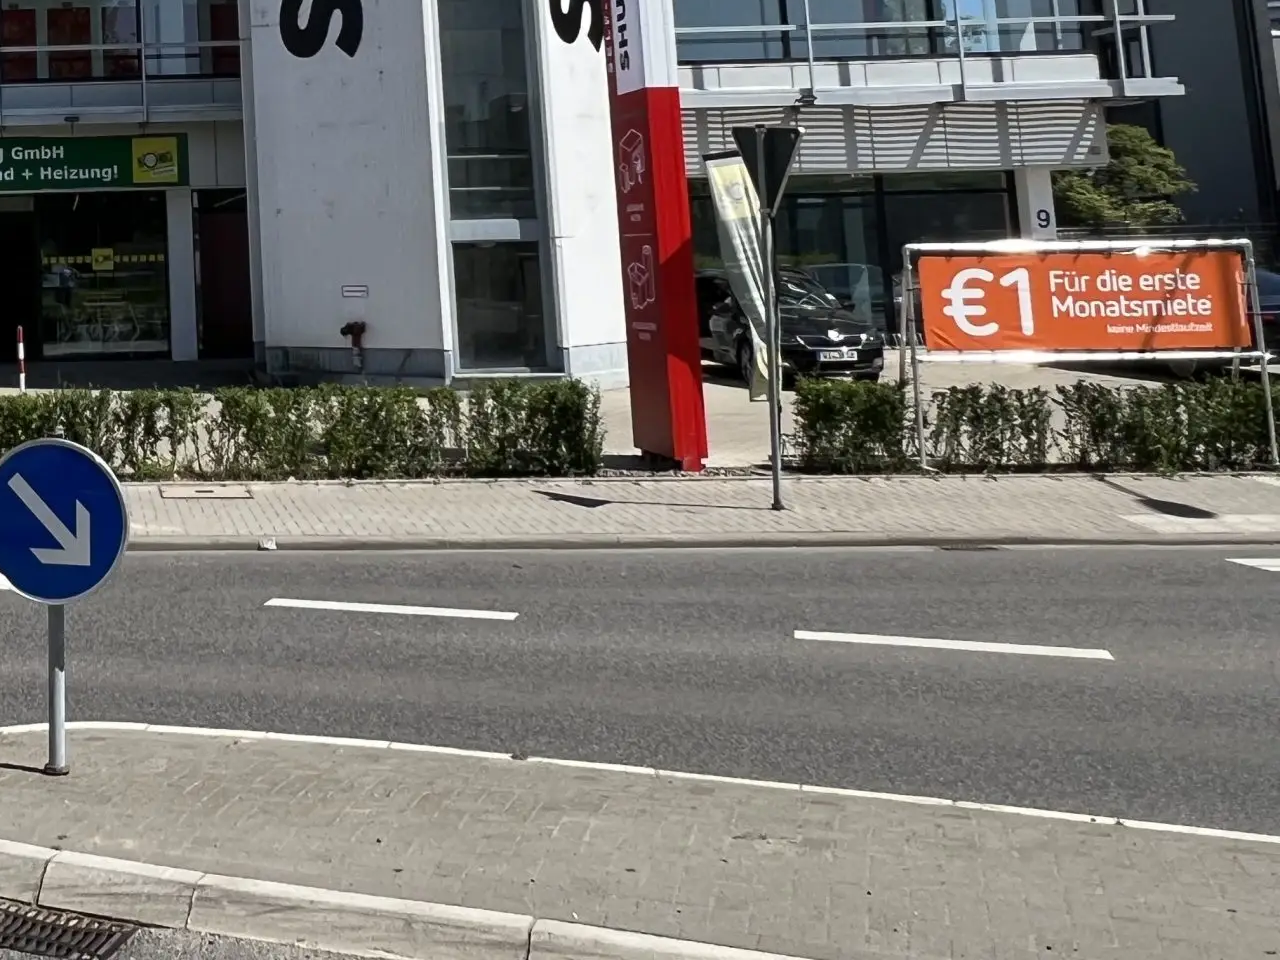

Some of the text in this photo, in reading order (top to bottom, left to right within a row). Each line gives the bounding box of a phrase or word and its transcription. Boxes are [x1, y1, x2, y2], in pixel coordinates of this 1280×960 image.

[11, 145, 64, 160] GmbH
[22, 168, 33, 180] +
[40, 165, 119, 182] Heizung!
[1036, 208, 1051, 229] 9
[1048, 268, 1201, 293] Für die erste
[941, 267, 1035, 337] €1
